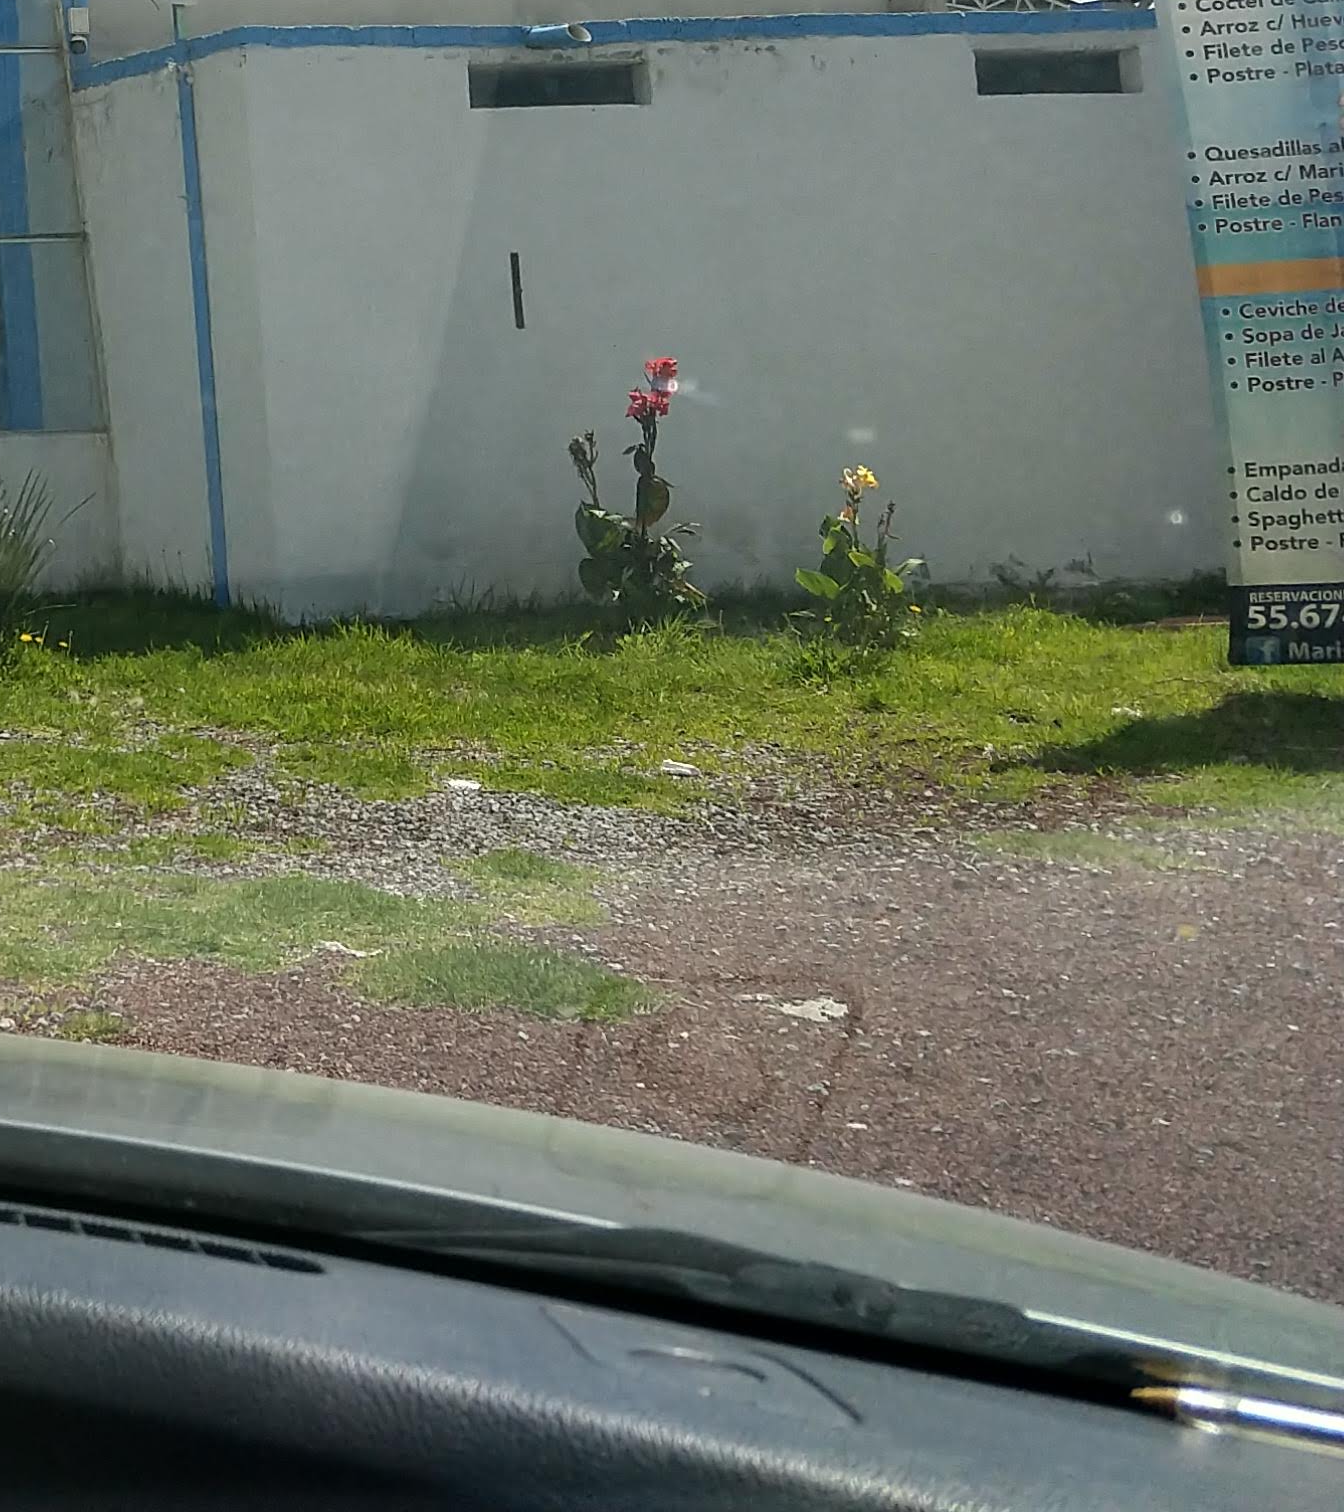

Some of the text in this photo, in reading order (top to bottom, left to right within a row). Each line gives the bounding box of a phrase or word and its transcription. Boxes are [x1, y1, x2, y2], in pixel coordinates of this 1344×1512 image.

[1200, 13, 1344, 36] Arroz c/ Huev
[1203, 42, 1263, 60] Filete
[1271, 38, 1295, 55] de
[1207, 67, 1275, 84] Postre
[1204, 139, 1321, 162] Quesadillas
[1209, 171, 1267, 186] Arroz
[1274, 164, 1291, 181] c/
[1212, 192, 1271, 209] Filete
[1278, 189, 1302, 206] de
[1215, 217, 1283, 233] Postre
[1302, 212, 1342, 228] Flan
[1239, 300, 1318, 319] Ceviche
[1242, 328, 1294, 346] Sopa
[1301, 323, 1324, 340] de
[1245, 351, 1303, 368] Filete
[1310, 347, 1326, 364] al
[1247, 376, 1314, 392] Postre
[1247, 483, 1339, 502] Caldo de
[1250, 536, 1319, 551] Postre
[1248, 604, 1344, 630] 55.67
[1288, 640, 1344, 660] Mari
